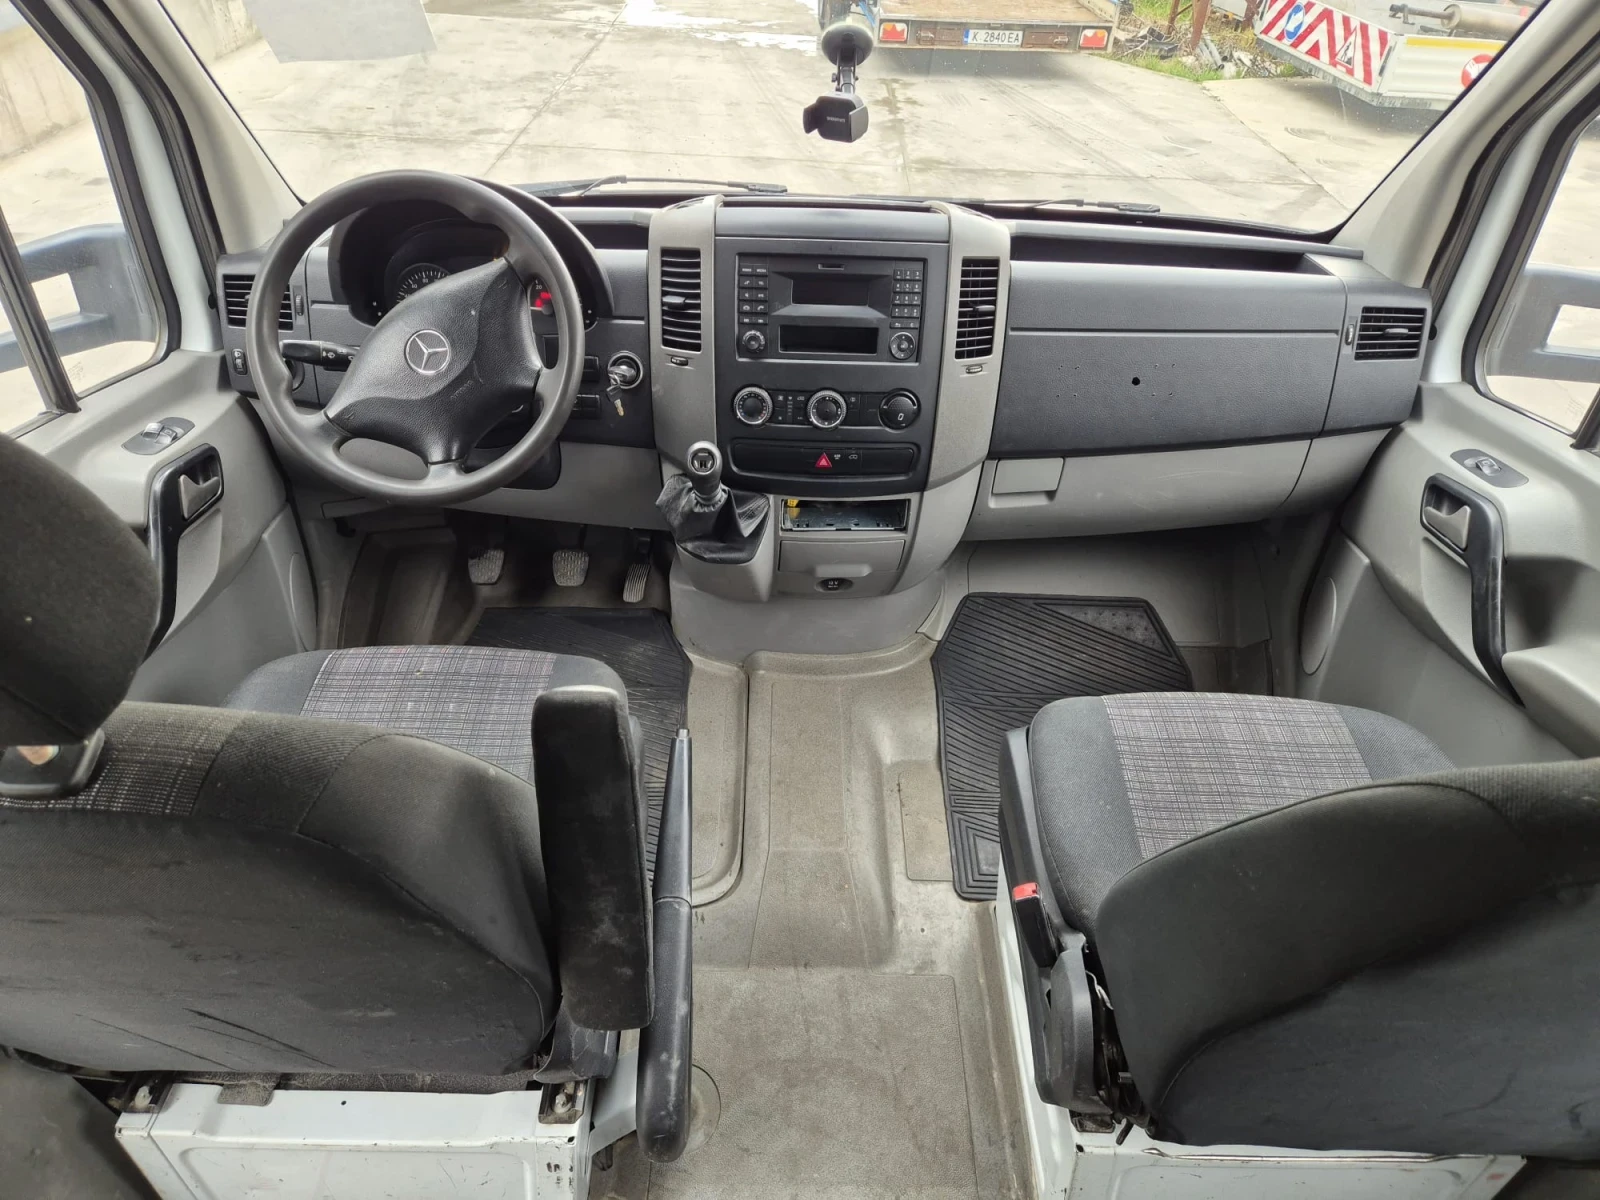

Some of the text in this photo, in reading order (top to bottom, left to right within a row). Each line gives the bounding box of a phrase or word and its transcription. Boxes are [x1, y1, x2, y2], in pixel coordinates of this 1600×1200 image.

[972, 31, 1019, 43] K 2840 EA
